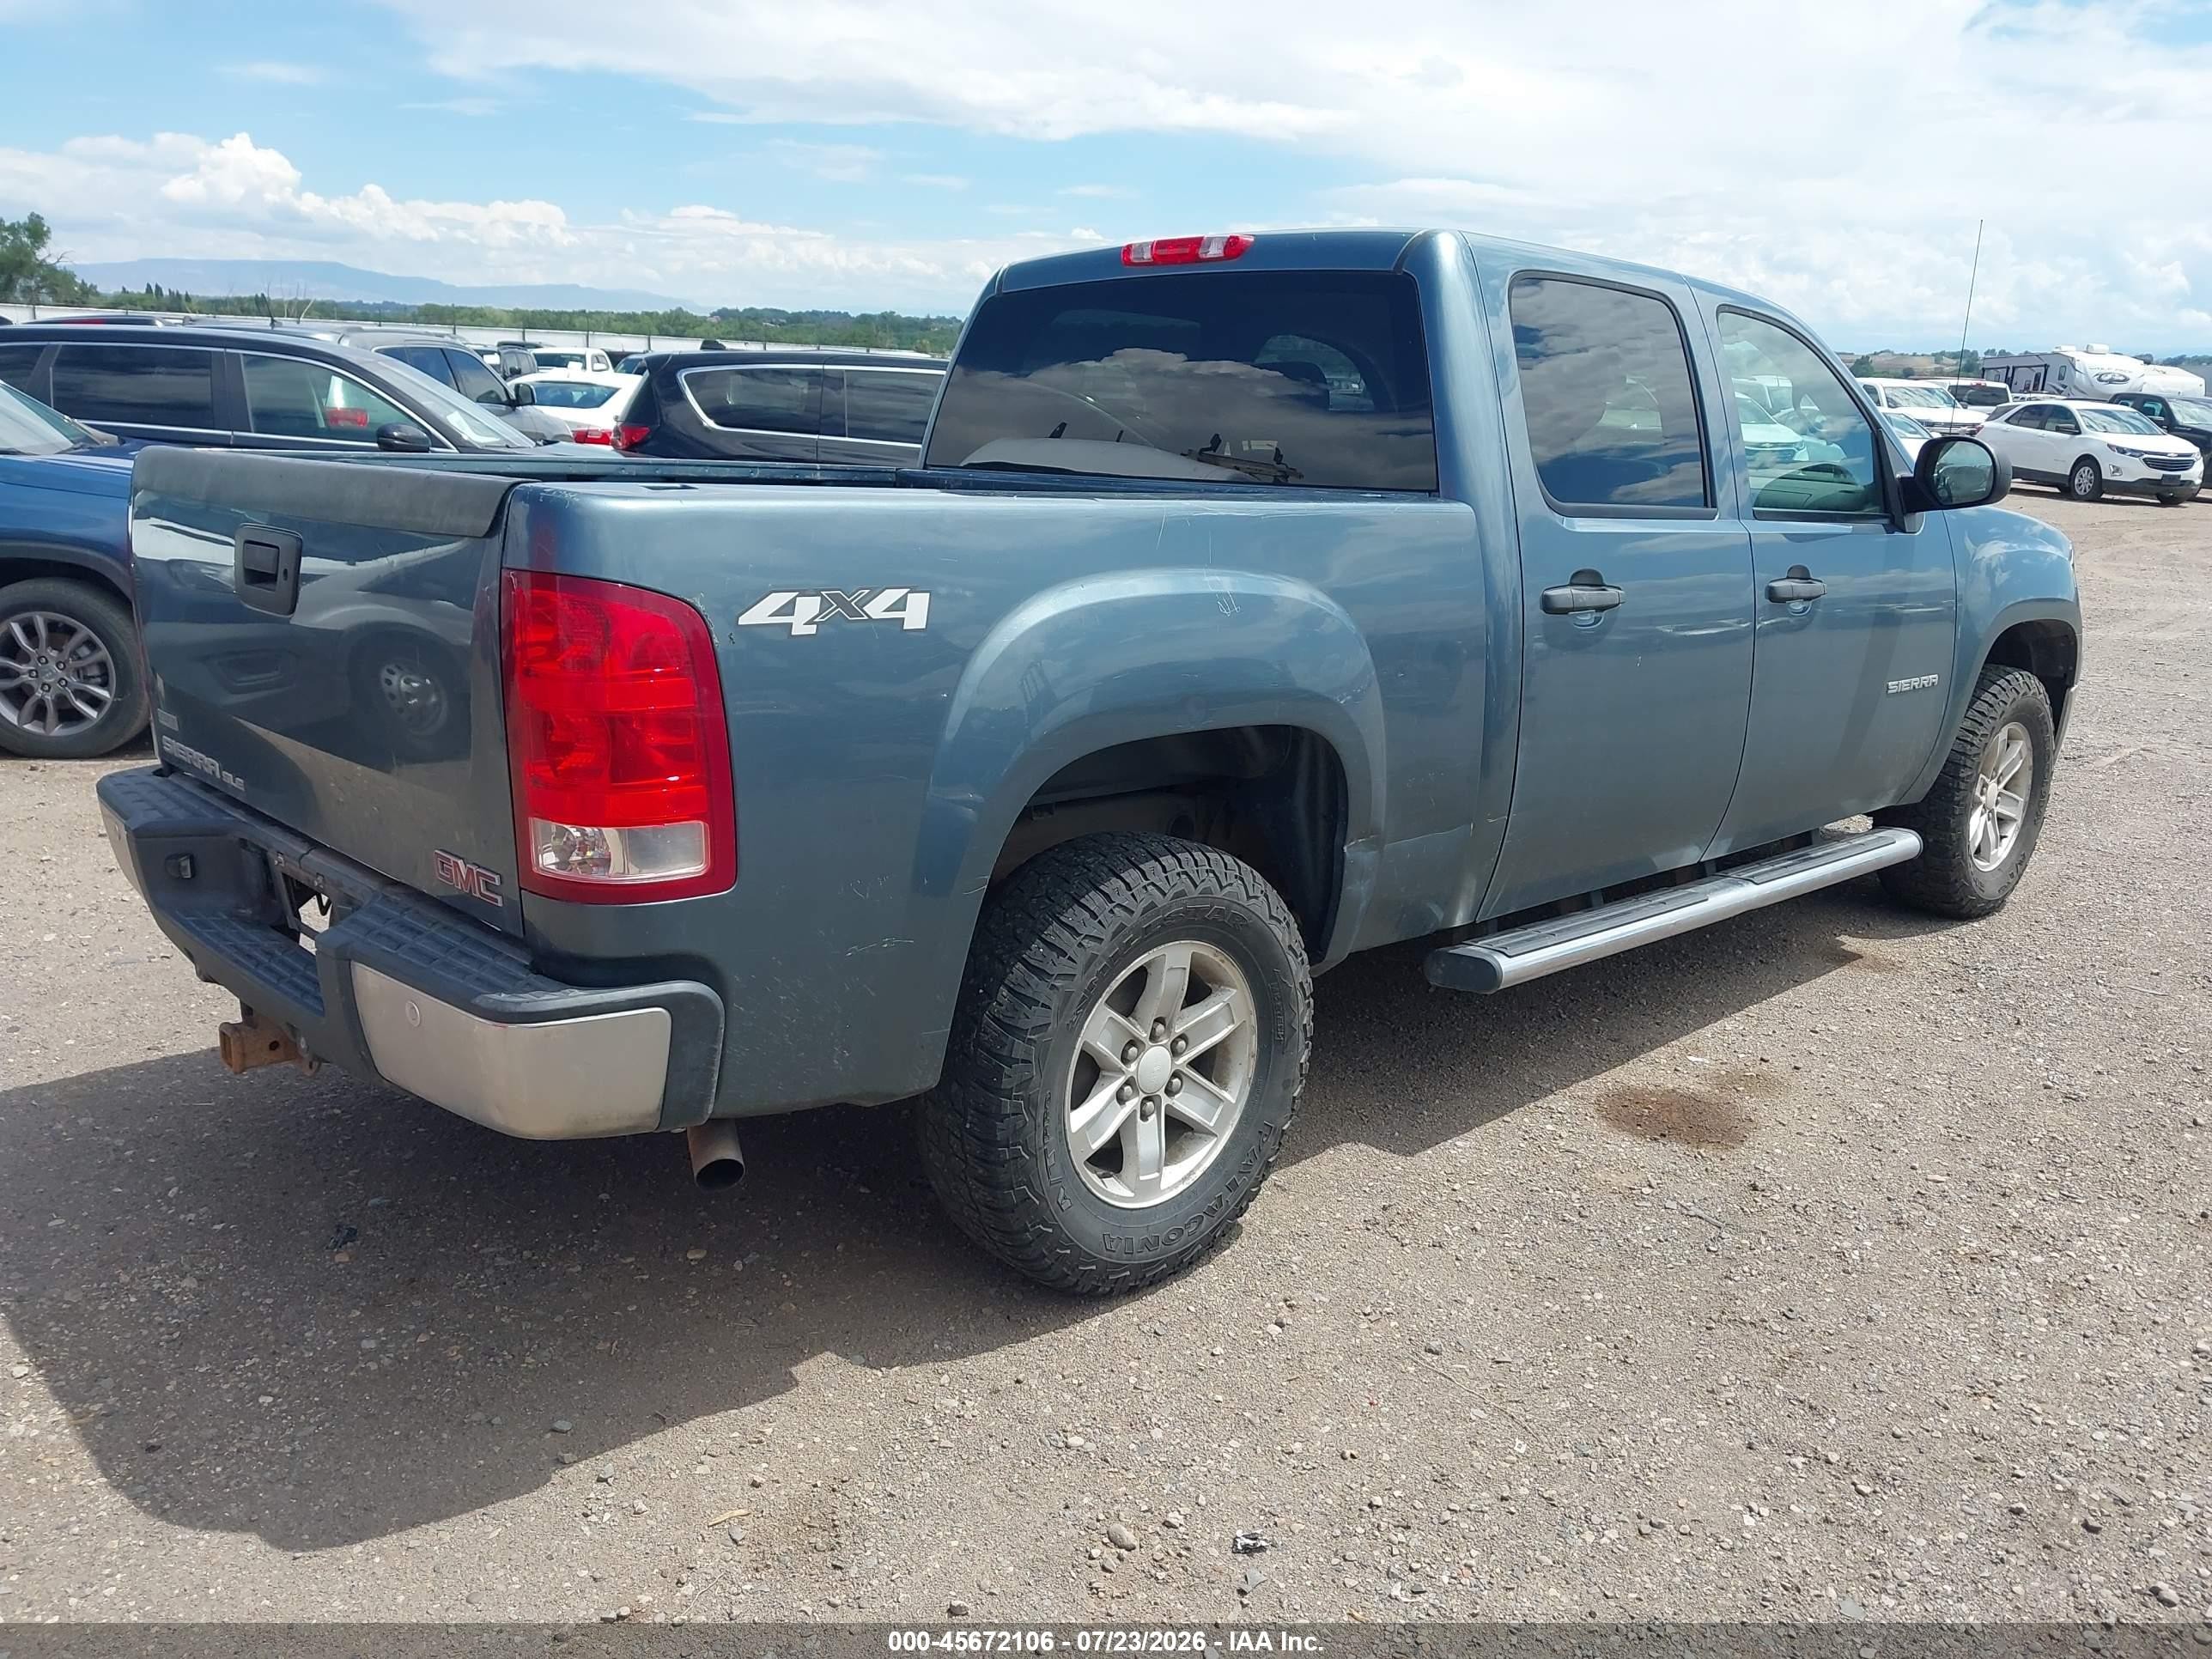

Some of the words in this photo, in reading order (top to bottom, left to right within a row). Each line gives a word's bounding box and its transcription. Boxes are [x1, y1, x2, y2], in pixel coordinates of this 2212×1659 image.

[1887, 673, 1939, 695] SIERRA
[161, 734, 221, 779] SIERRA
[434, 848, 503, 908] GMC
[1102, 1120, 1281, 1255] PATAGONIA
